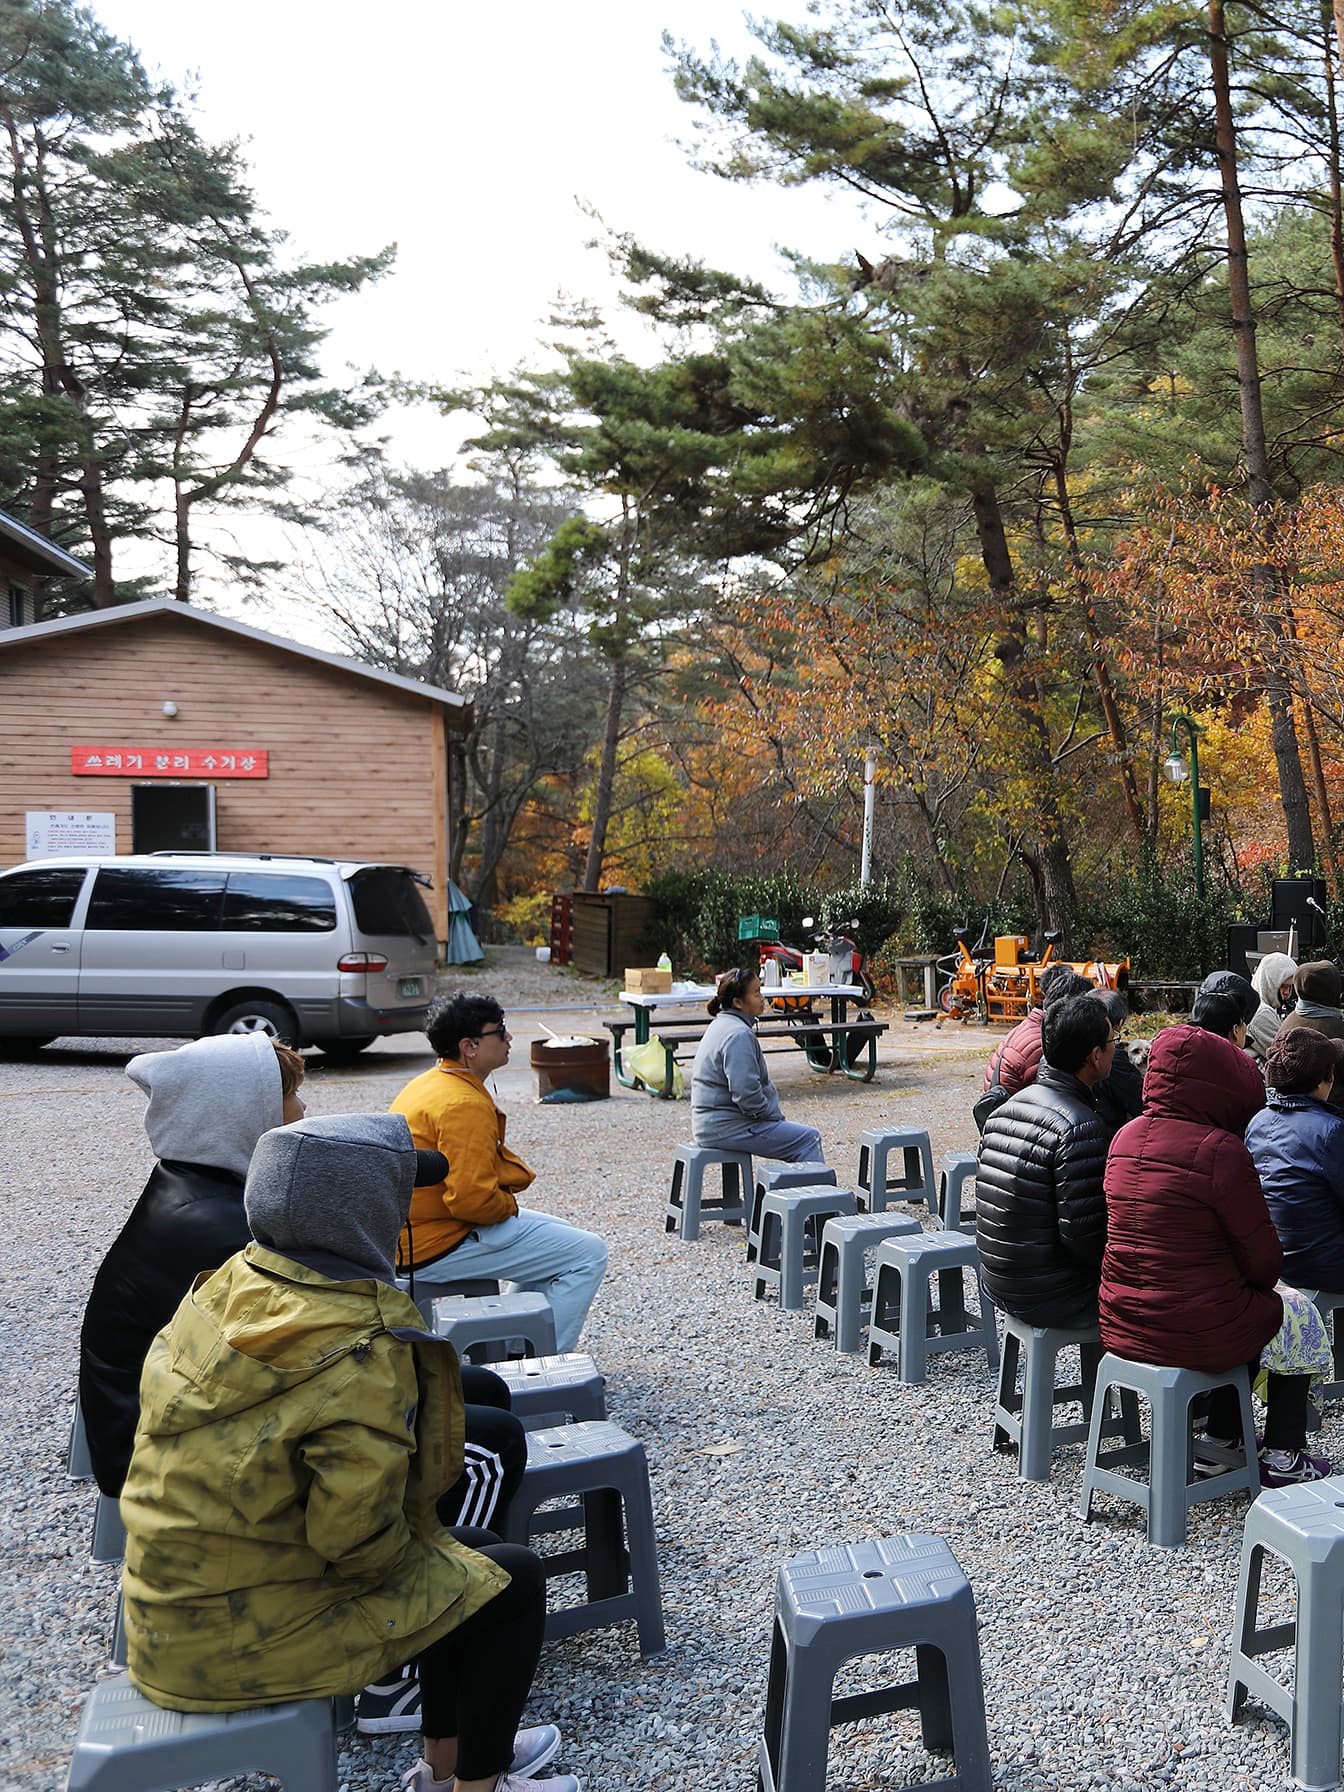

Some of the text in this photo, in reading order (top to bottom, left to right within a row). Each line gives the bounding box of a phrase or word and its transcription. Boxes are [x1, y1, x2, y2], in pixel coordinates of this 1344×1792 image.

[84, 754, 257, 771] 쓰레기 분리 수거장
